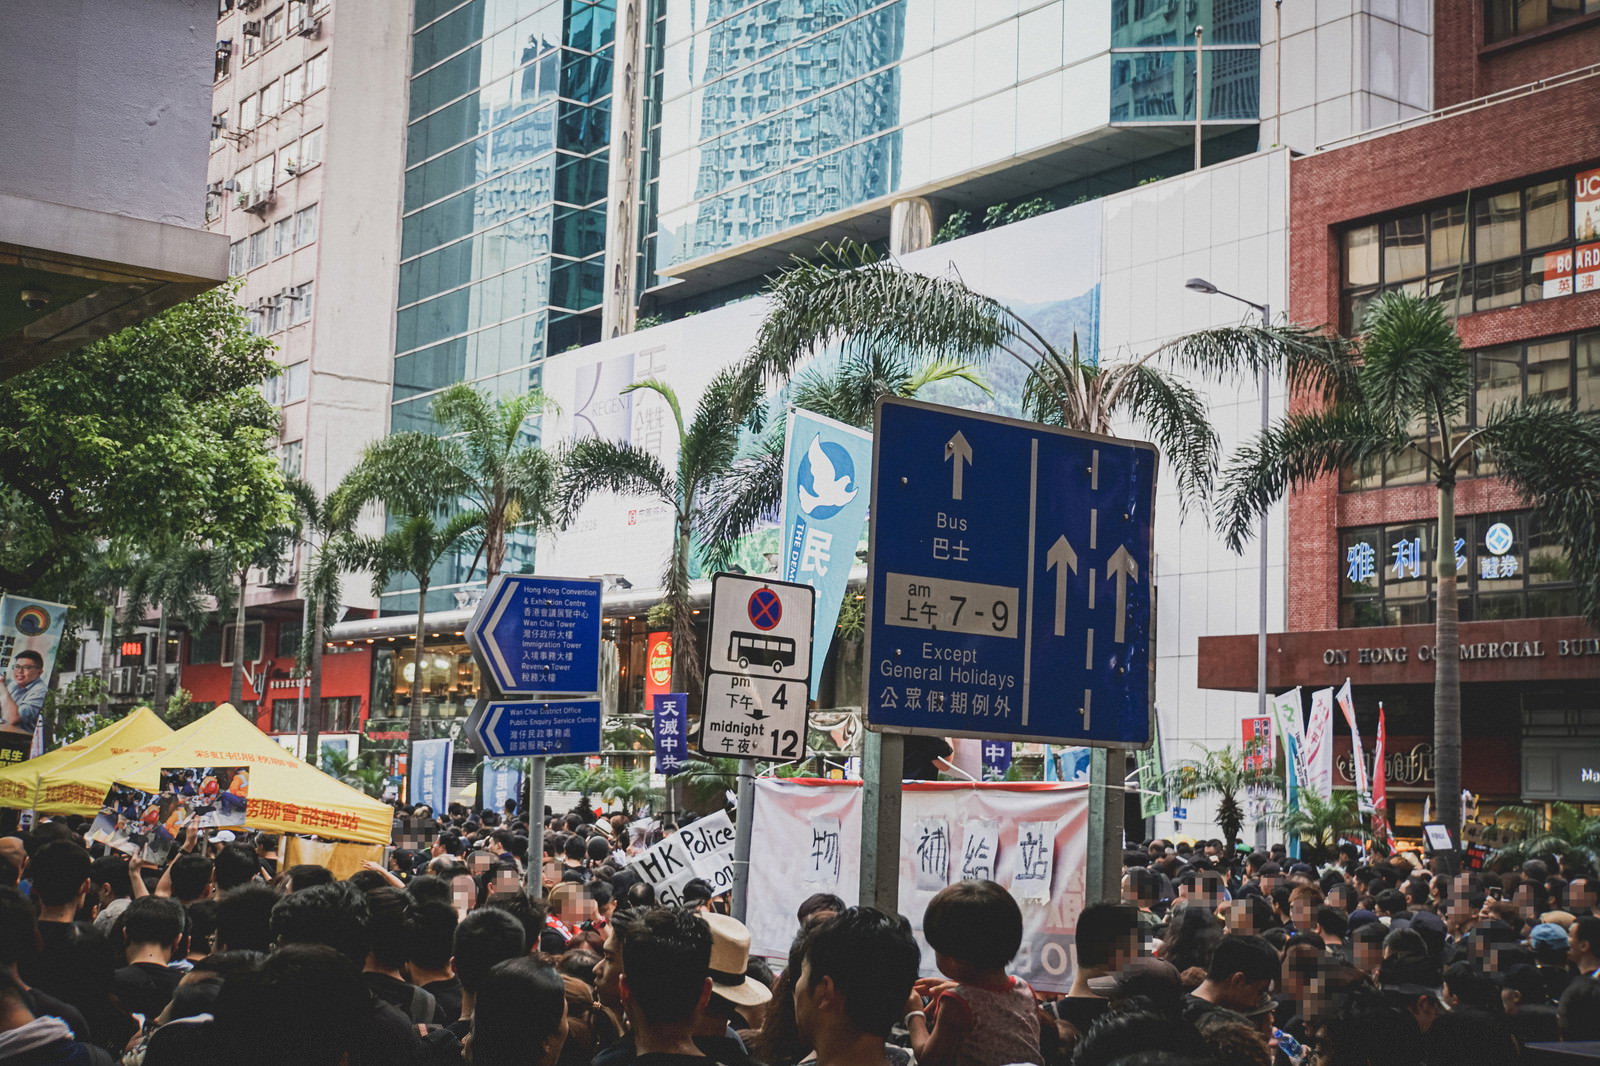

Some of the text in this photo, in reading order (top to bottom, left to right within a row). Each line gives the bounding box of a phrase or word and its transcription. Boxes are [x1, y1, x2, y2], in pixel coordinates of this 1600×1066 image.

[937, 512, 968, 532] Bus
[787, 523, 806, 583] THE DEM
[932, 537, 970, 562] 巴士
[523, 586, 597, 596] Hong Kong Convention
[908, 583, 931, 598] am
[564, 599, 586, 607] Centre
[900, 600, 938, 625] 上午
[556, 620, 576, 628] Tower
[522, 629, 574, 640] 灣仔政府大樓
[522, 640, 582, 649] Immigration Tower
[922, 642, 977, 665] Except
[522, 650, 574, 662] 入境事務大樓
[1323, 648, 1350, 665] ON
[1357, 646, 1408, 664] HONG
[551, 663, 571, 671] Tower
[880, 659, 1015, 691] General Holidays
[731, 676, 751, 689] pm
[725, 683, 788, 711] 下午 4
[880, 685, 1012, 719] 公眾假期例外
[510, 706, 582, 716] Wan Chai District Office
[530, 718, 552, 726] Enquiry
[553, 717, 575, 725] Service
[577, 716, 597, 724] Centre
[659, 701, 680, 770] 天滅中共
[710, 720, 799, 758] midnight 12
[721, 736, 751, 754] 午夜
[638, 826, 736, 884] HK Police
[810, 826, 840, 875] 物
